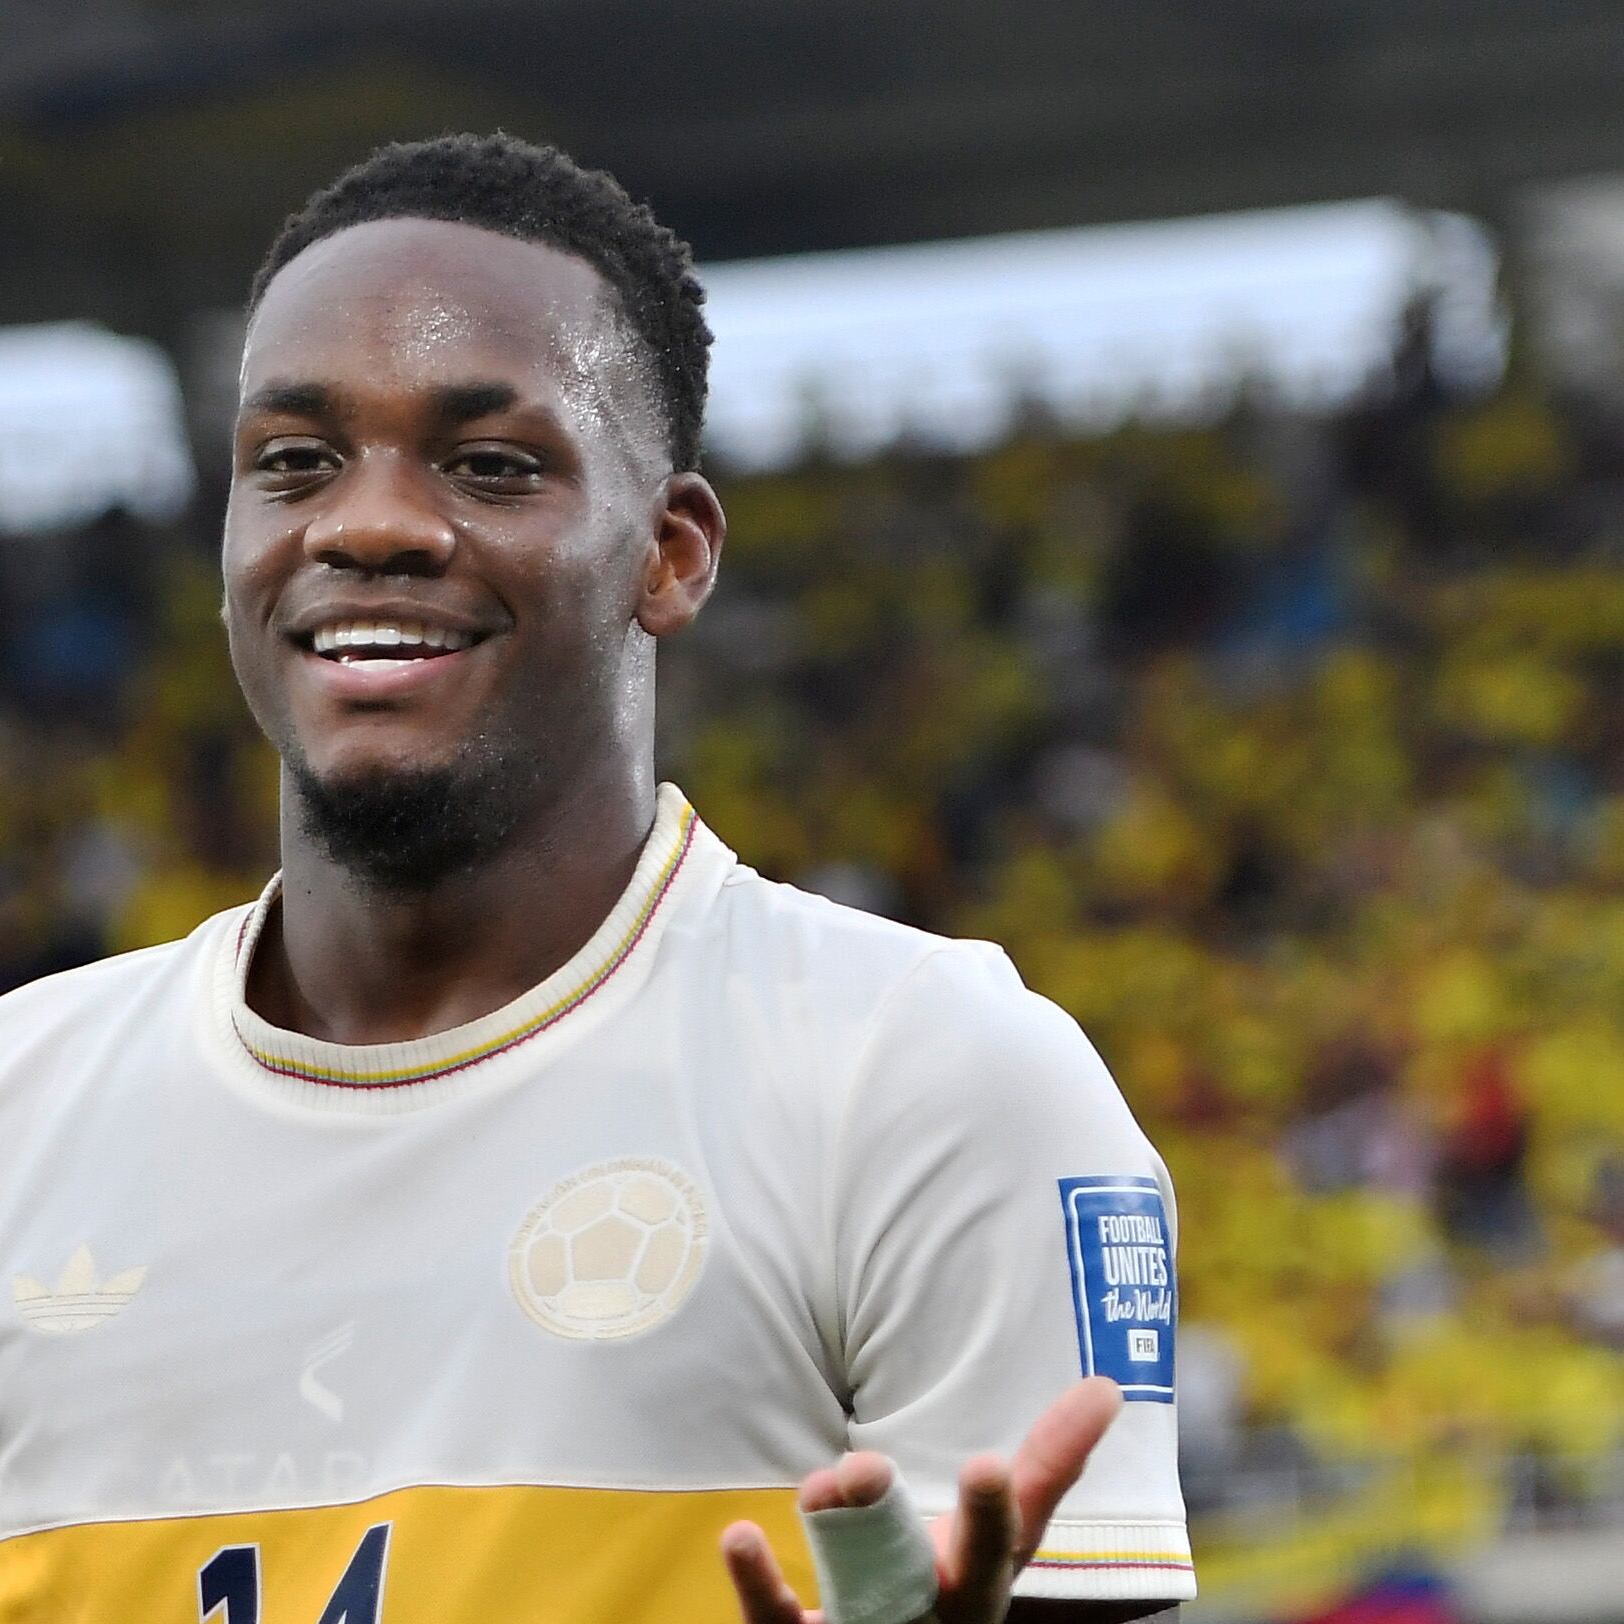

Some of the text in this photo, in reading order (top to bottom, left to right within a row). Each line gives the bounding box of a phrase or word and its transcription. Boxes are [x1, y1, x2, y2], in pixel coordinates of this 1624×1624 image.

[1098, 1216, 1164, 1244] FOOTBALL
[1102, 1246, 1167, 1285] UNITES
[1101, 1288, 1172, 1326] the World
